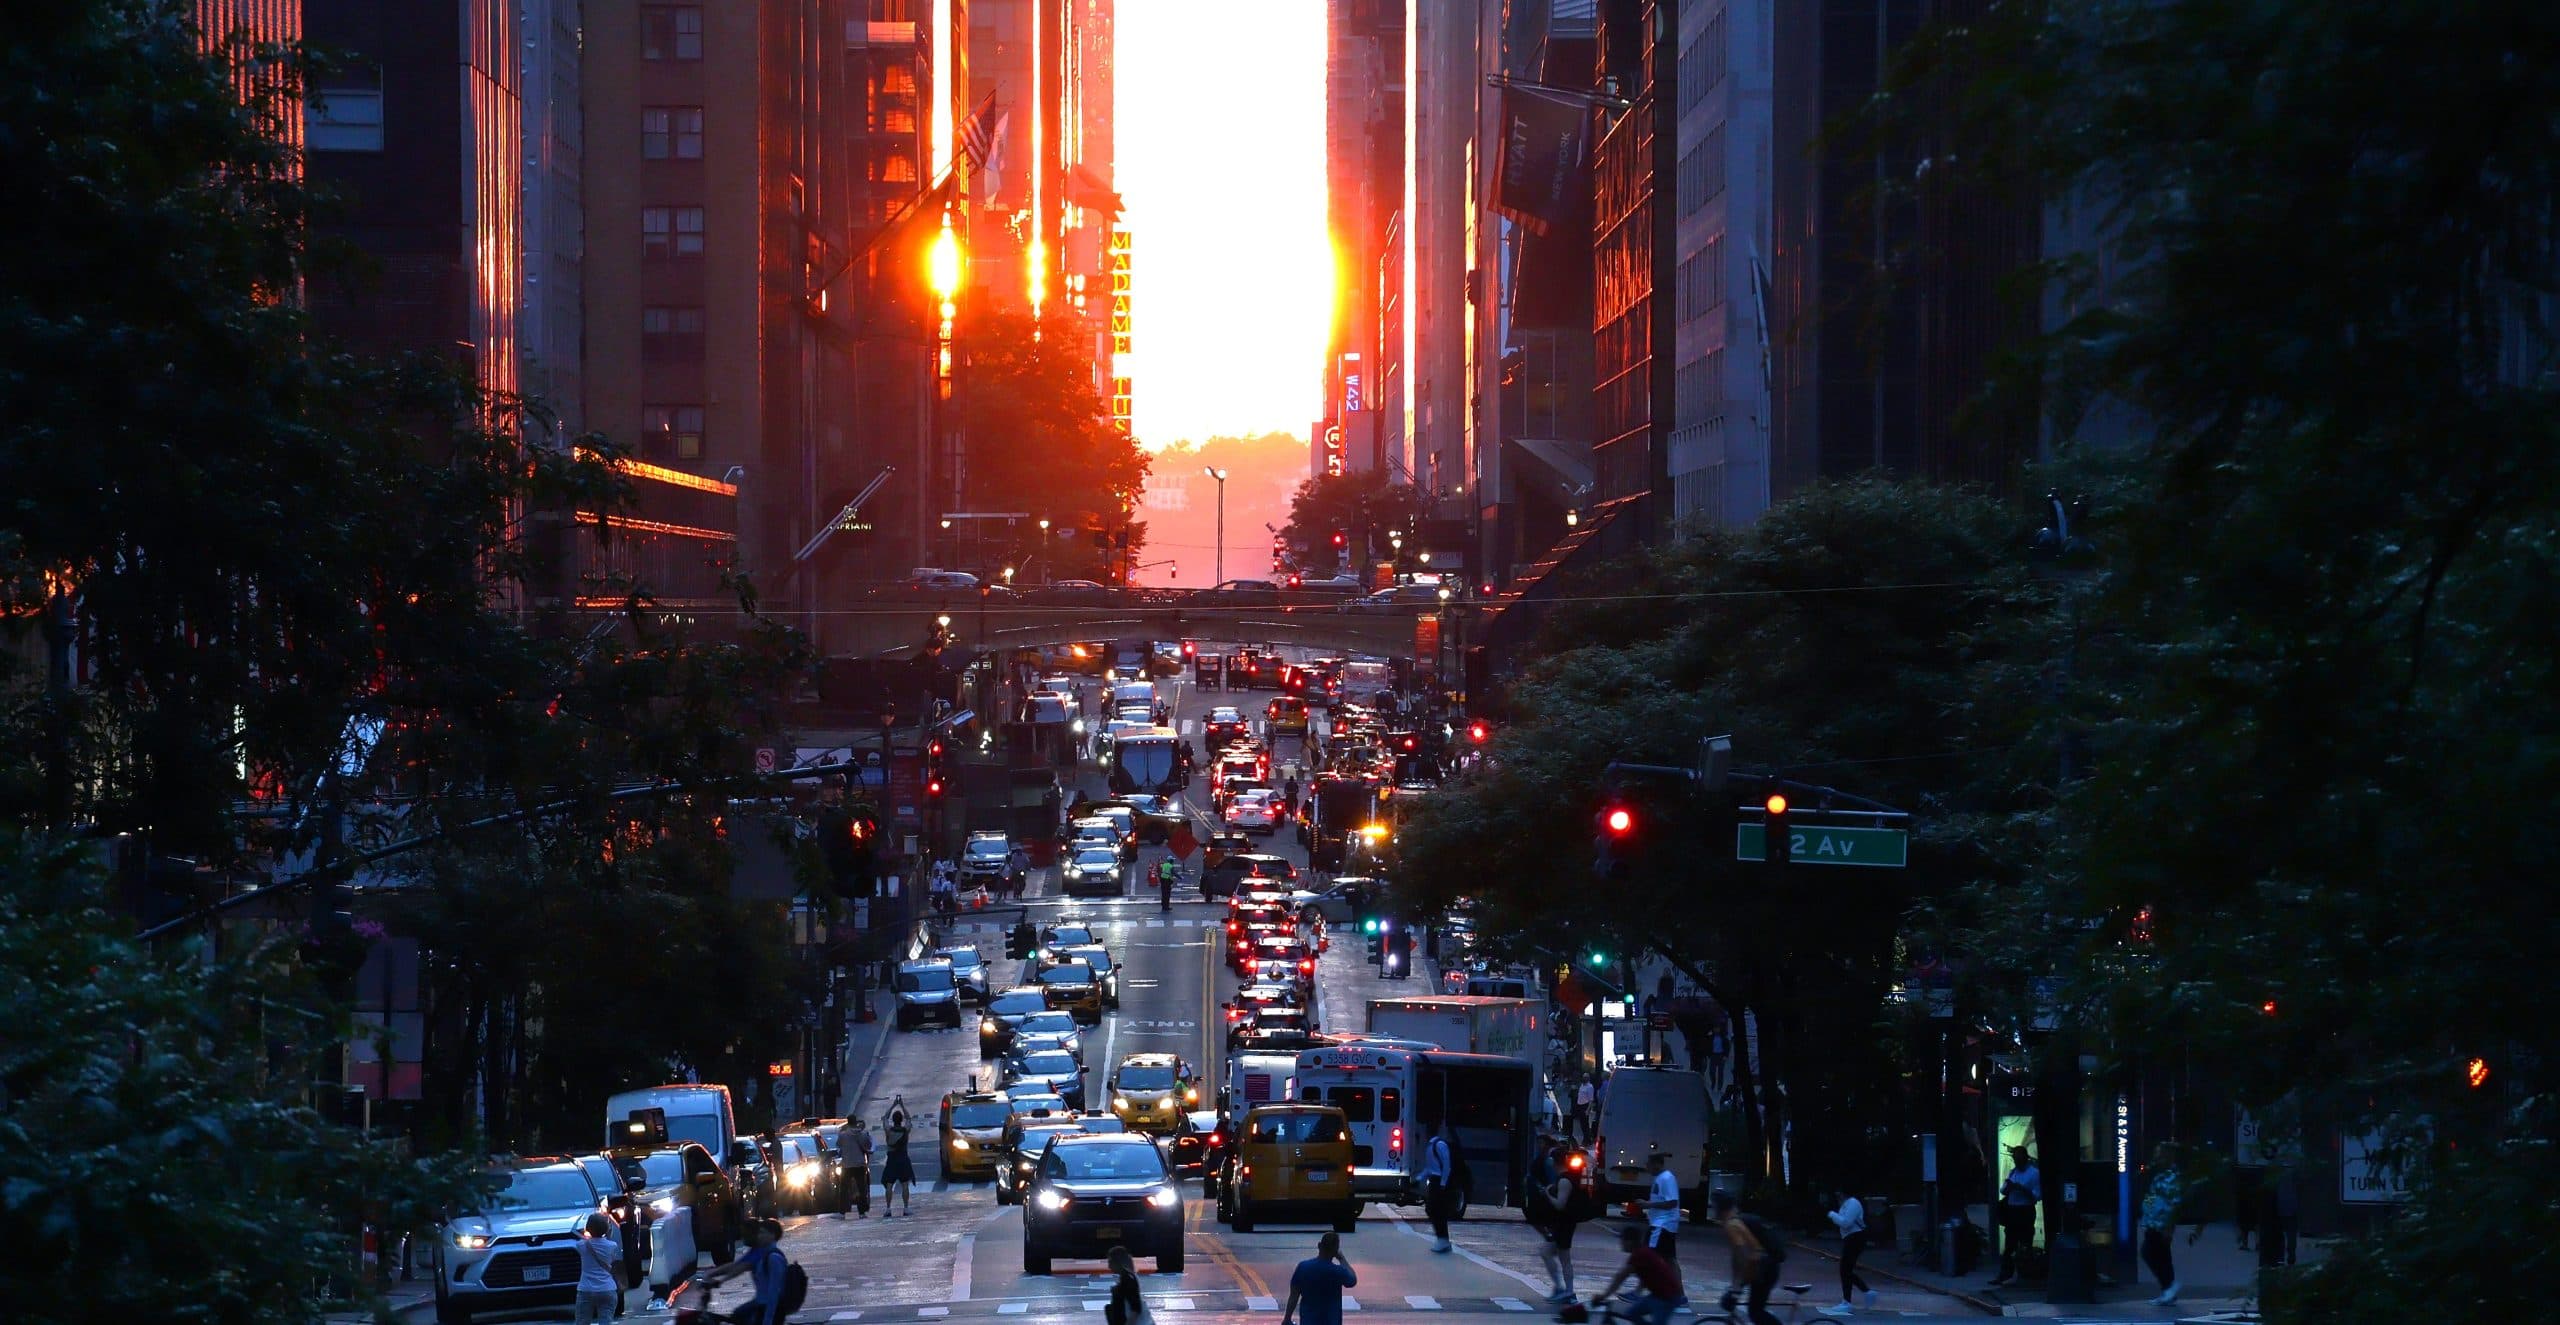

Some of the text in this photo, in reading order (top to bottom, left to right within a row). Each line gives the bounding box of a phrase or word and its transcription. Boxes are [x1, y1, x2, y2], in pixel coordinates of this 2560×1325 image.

[1111, 231, 1131, 354] MADAME
[1790, 834, 1854, 856] 2 Av
[2118, 1106, 2127, 1117] St
[2118, 1137, 2128, 1173] Avenue
